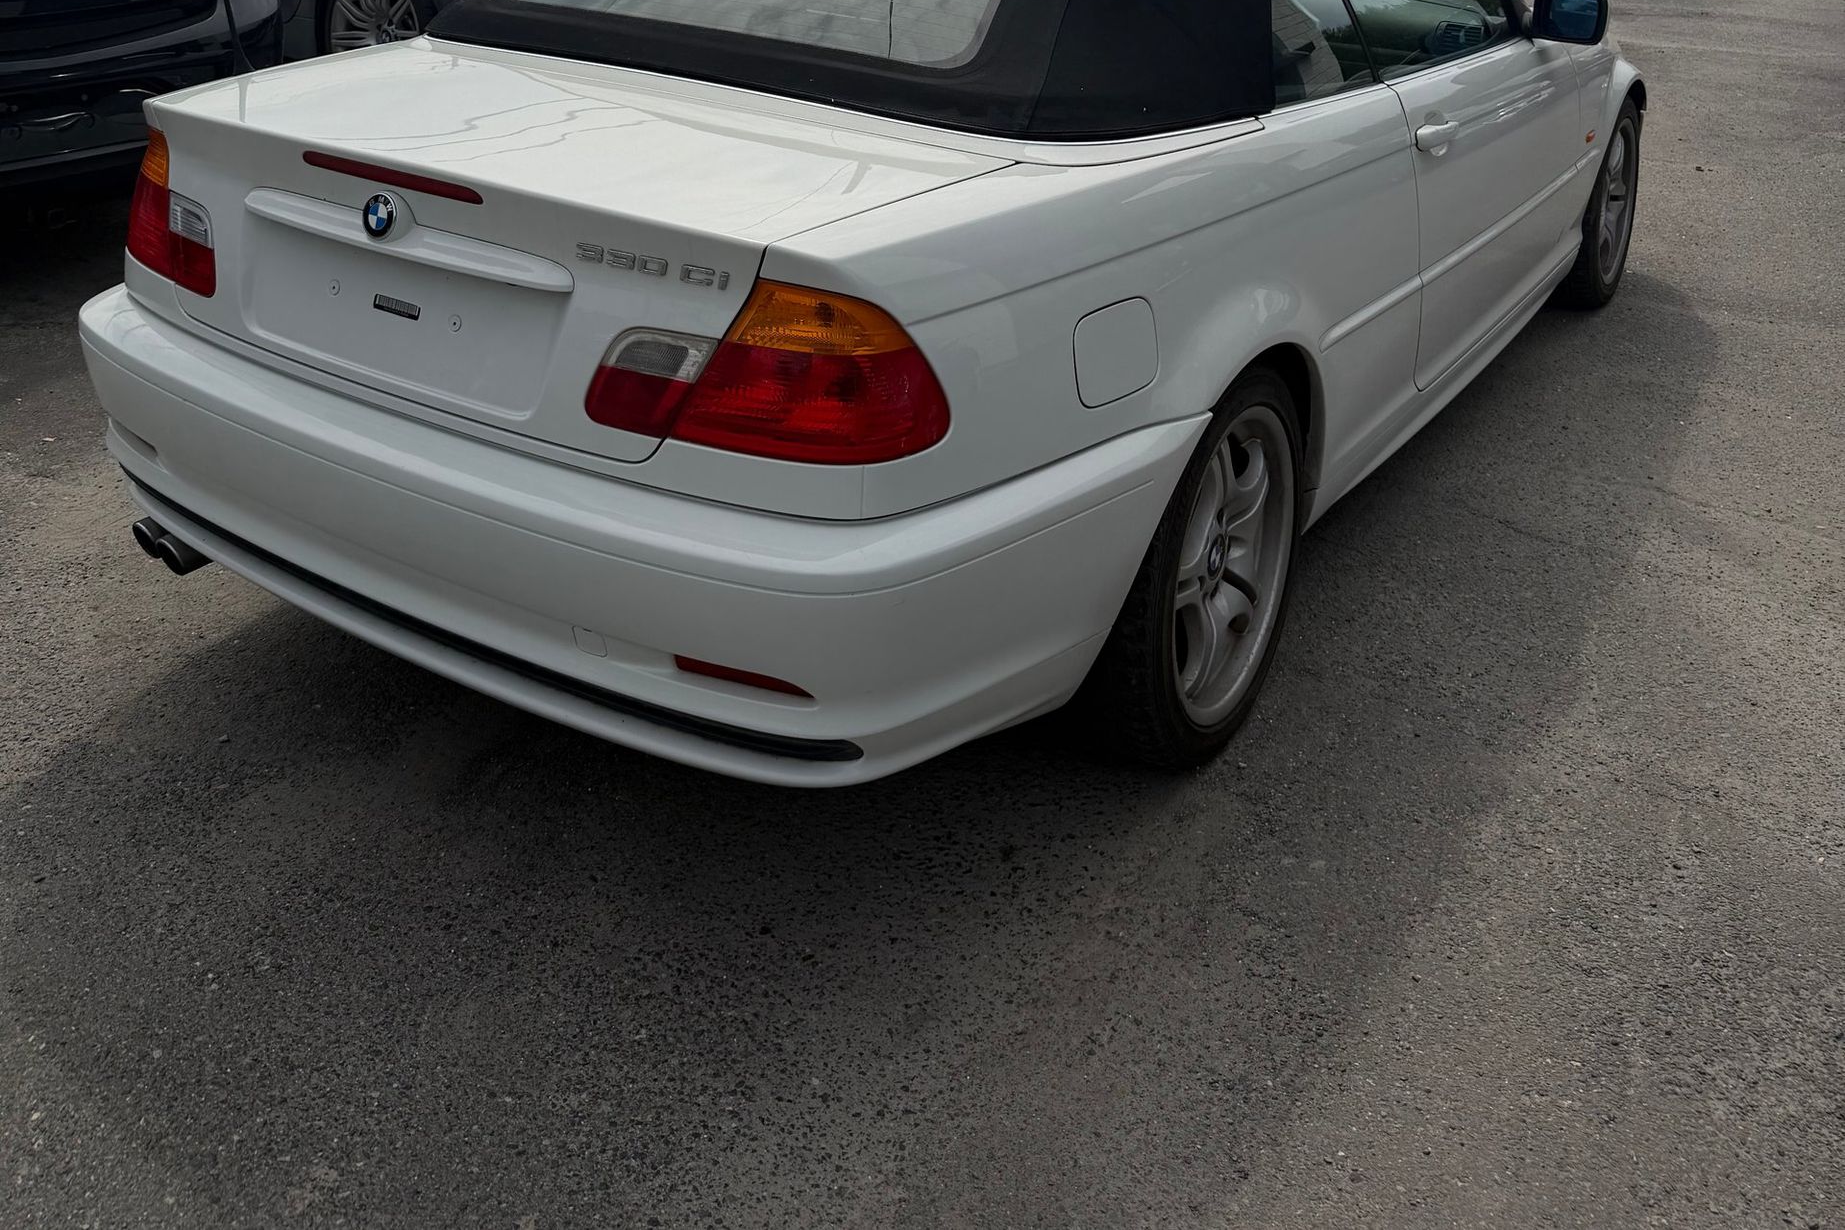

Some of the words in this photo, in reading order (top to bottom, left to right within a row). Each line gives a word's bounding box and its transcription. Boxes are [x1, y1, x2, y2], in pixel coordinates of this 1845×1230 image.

[368, 195, 393, 212] BMW
[576, 241, 669, 277] 330
[679, 263, 730, 291] Ci
